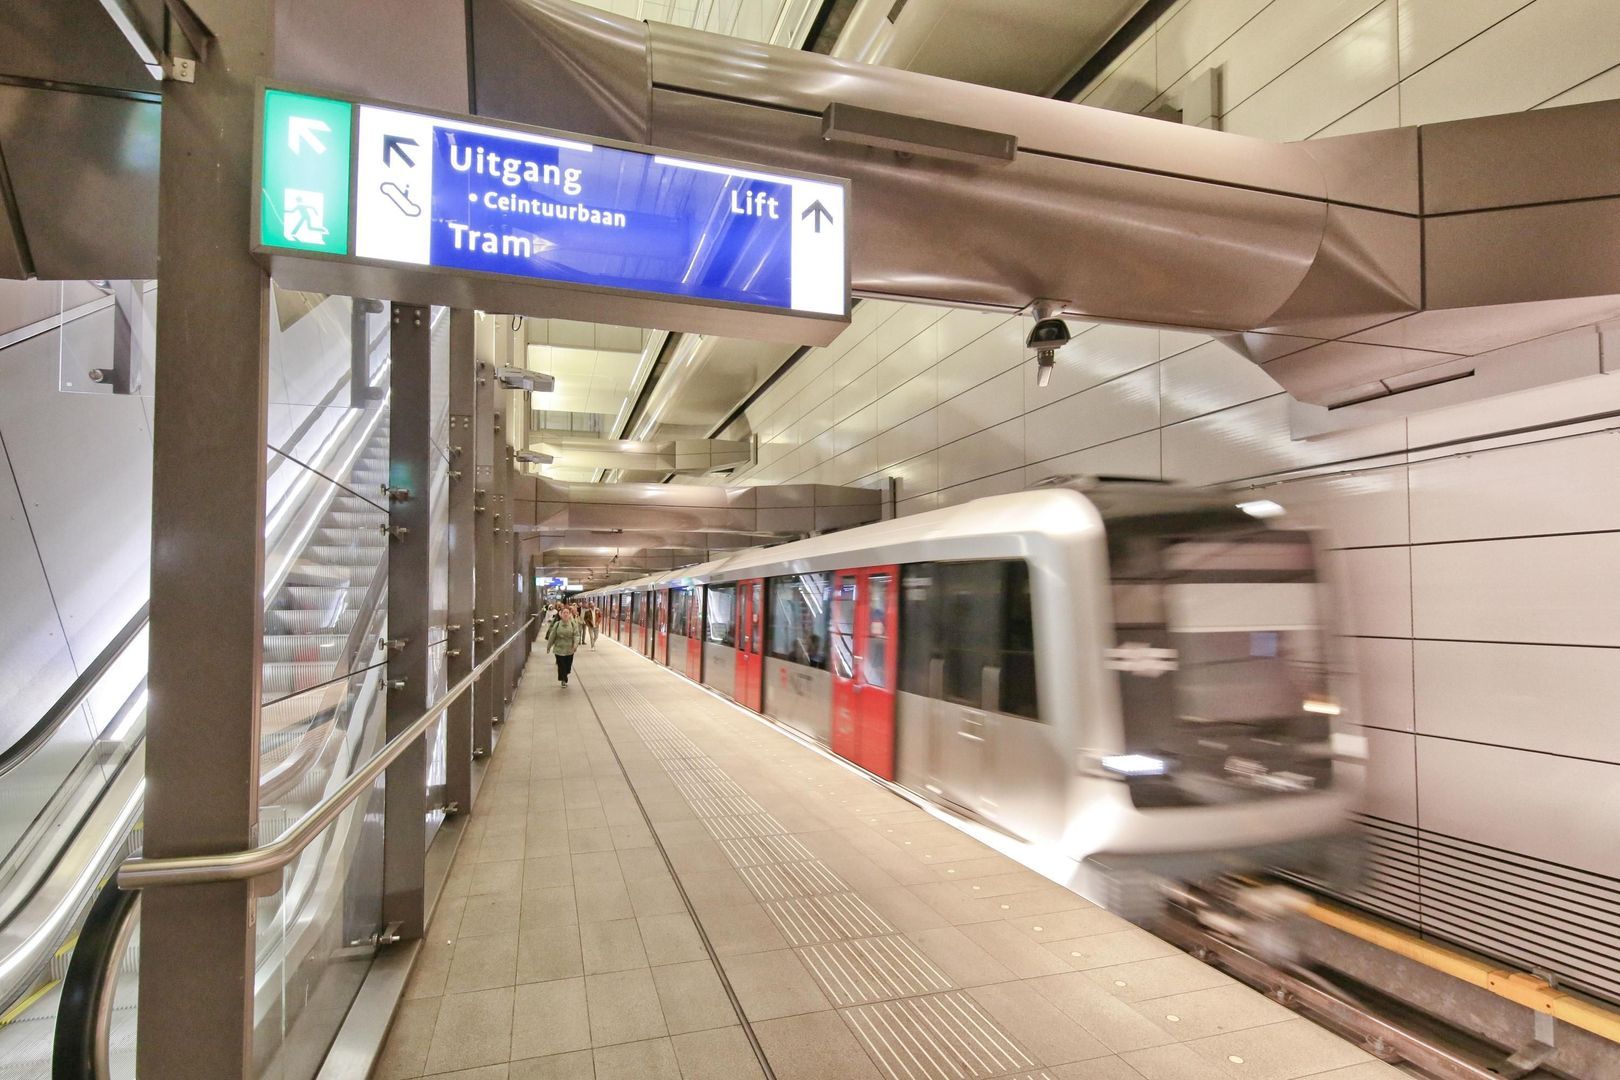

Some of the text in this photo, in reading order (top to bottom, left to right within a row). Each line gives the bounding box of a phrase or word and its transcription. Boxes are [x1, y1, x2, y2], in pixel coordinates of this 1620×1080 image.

[449, 144, 583, 195] Uitgang
[483, 191, 627, 228] Ceintuurbaan
[730, 190, 779, 220] Lift
[449, 223, 531, 259] Tram
